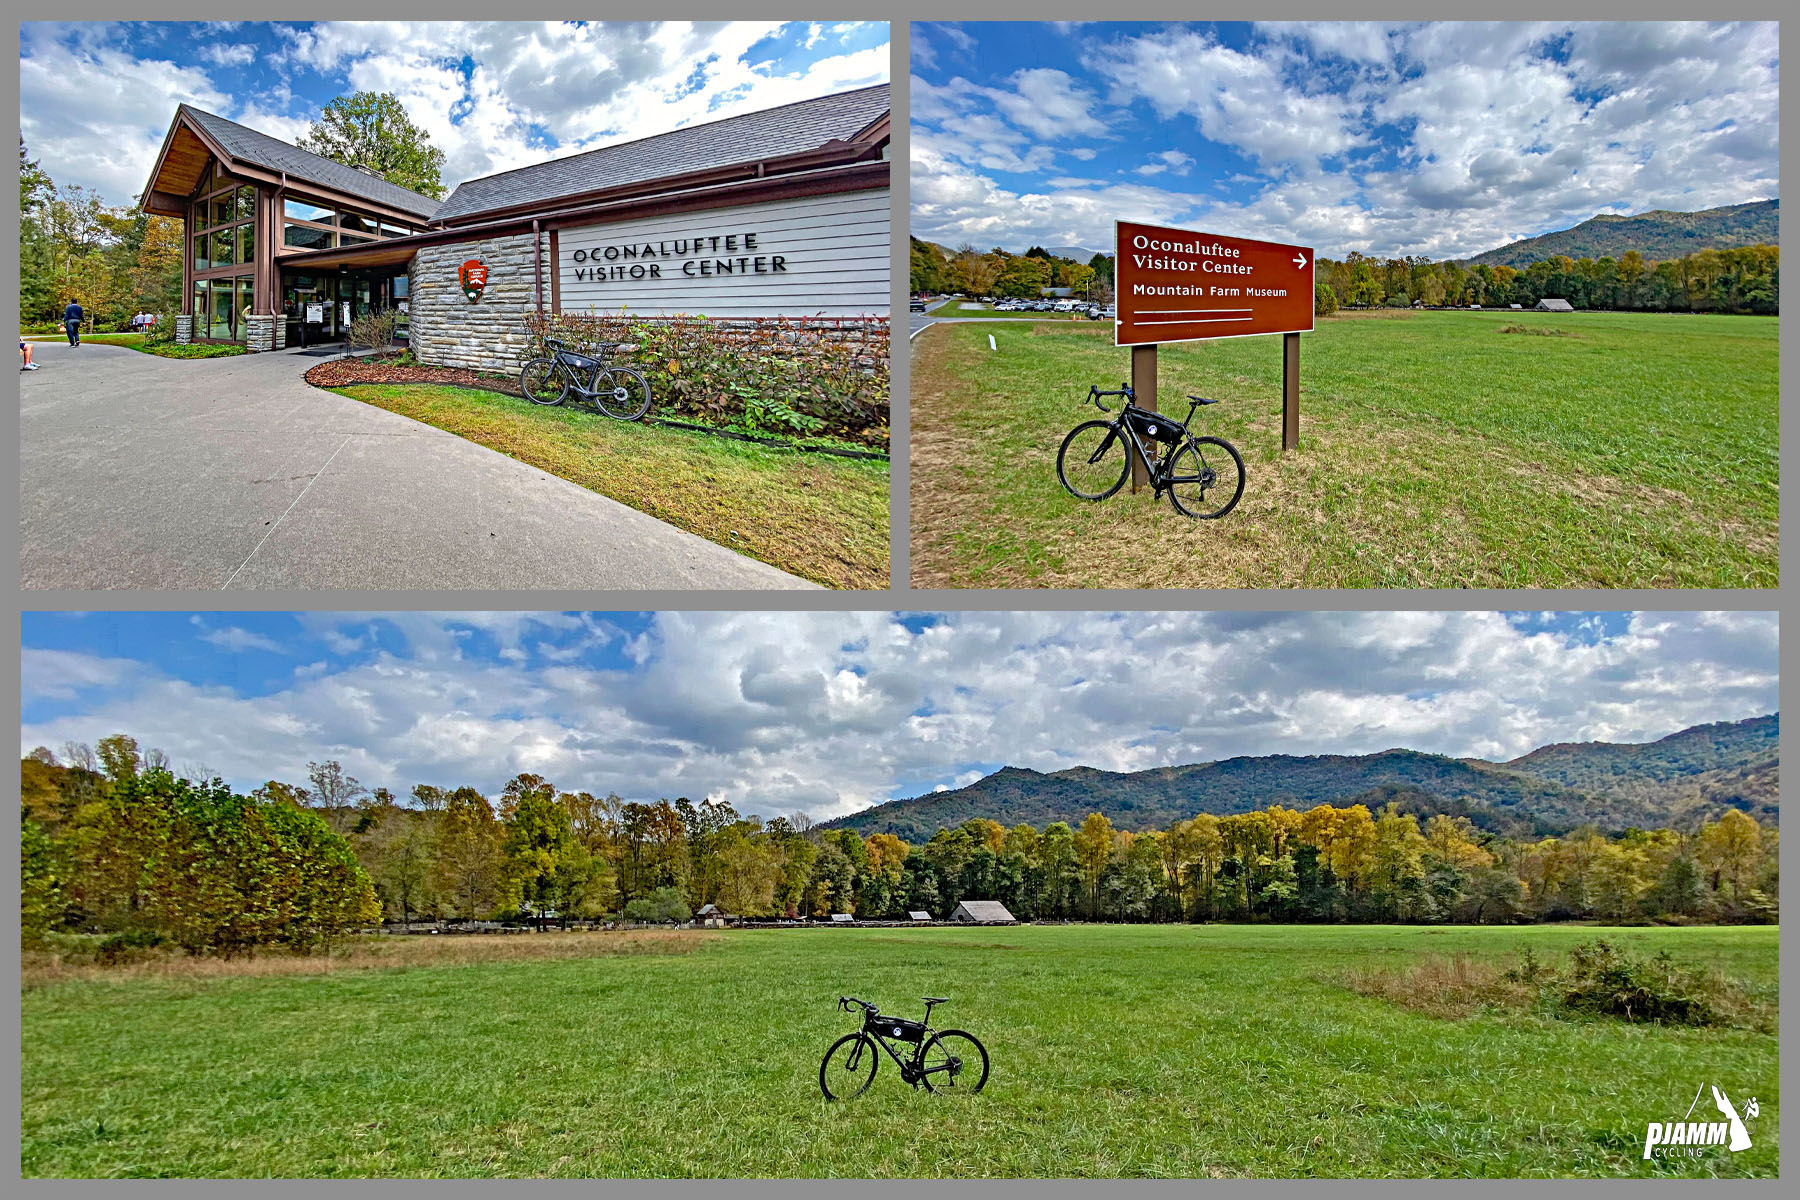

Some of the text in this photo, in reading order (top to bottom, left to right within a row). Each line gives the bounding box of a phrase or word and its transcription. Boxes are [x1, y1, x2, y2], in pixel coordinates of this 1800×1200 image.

[573, 233, 758, 262] OCONALUFTEE
[1133, 235, 1240, 258] Oconaluftee
[574, 255, 787, 281] VISITOR CENTER
[1133, 254, 1253, 275] Visitor Center
[1133, 284, 1287, 297] Mountain Farm Museum
